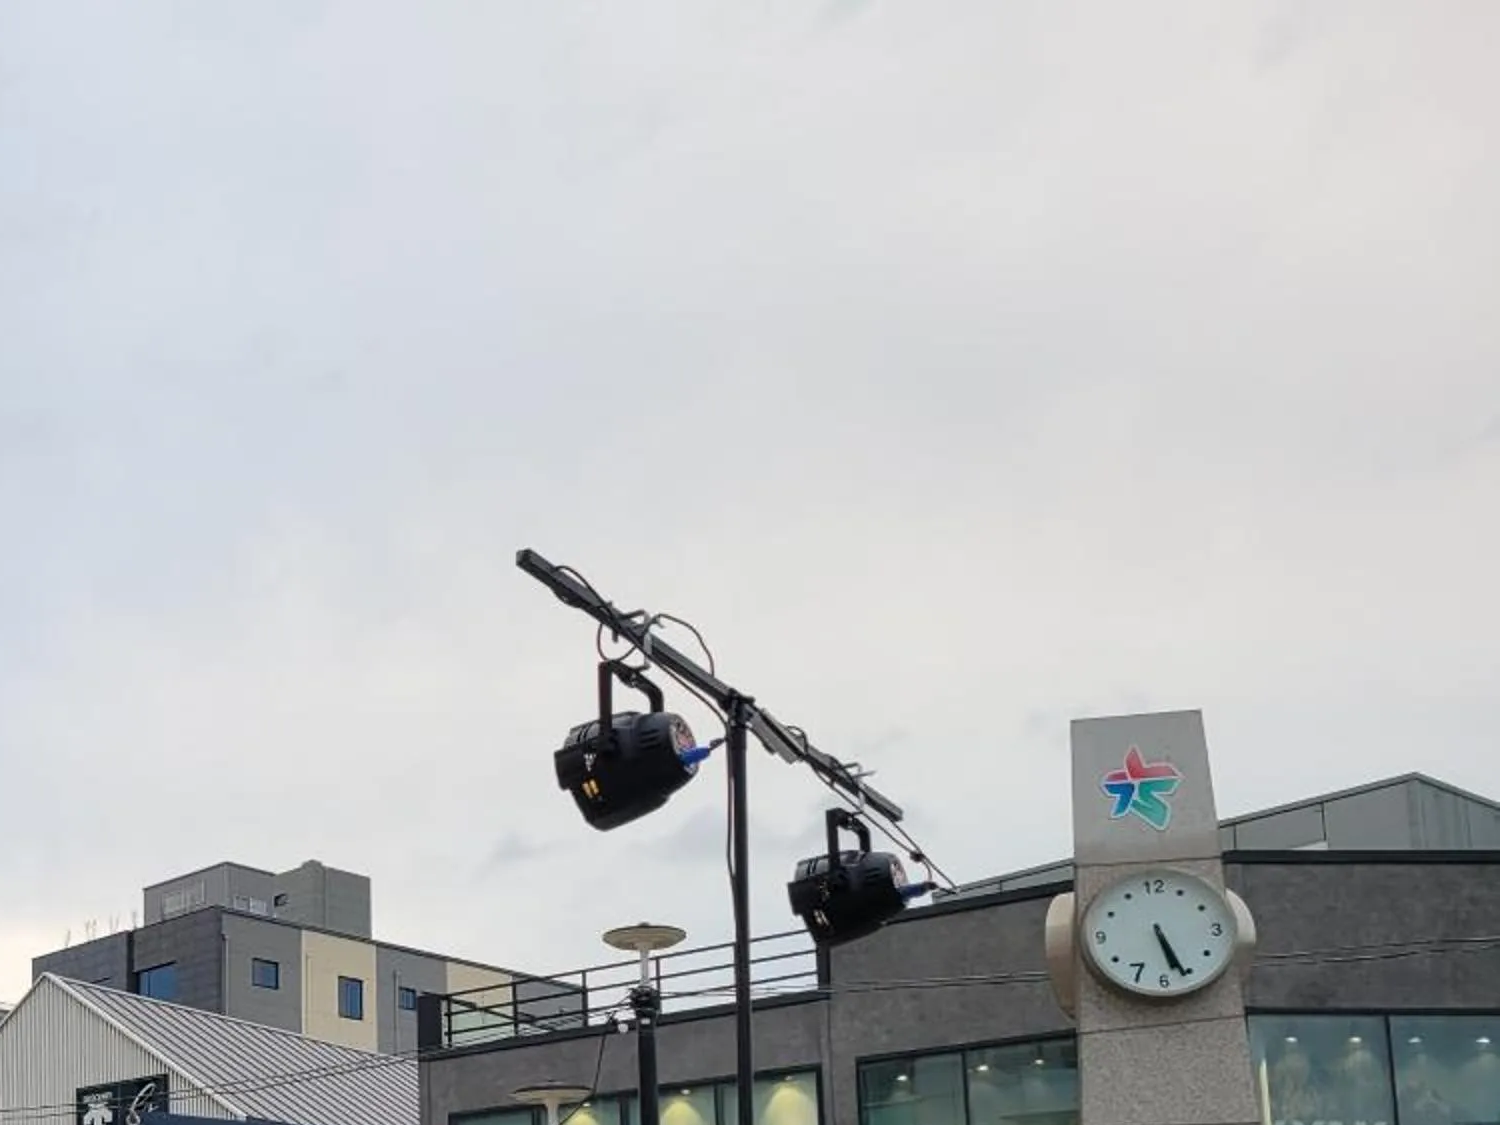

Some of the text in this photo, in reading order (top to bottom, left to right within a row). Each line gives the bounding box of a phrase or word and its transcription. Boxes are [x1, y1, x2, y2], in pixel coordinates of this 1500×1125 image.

[1144, 879, 1165, 895] 12
[1211, 922, 1223, 937] 3
[1095, 930, 1107, 945] 9
[1129, 961, 1146, 983] 7
[1159, 973, 1171, 988] 6
